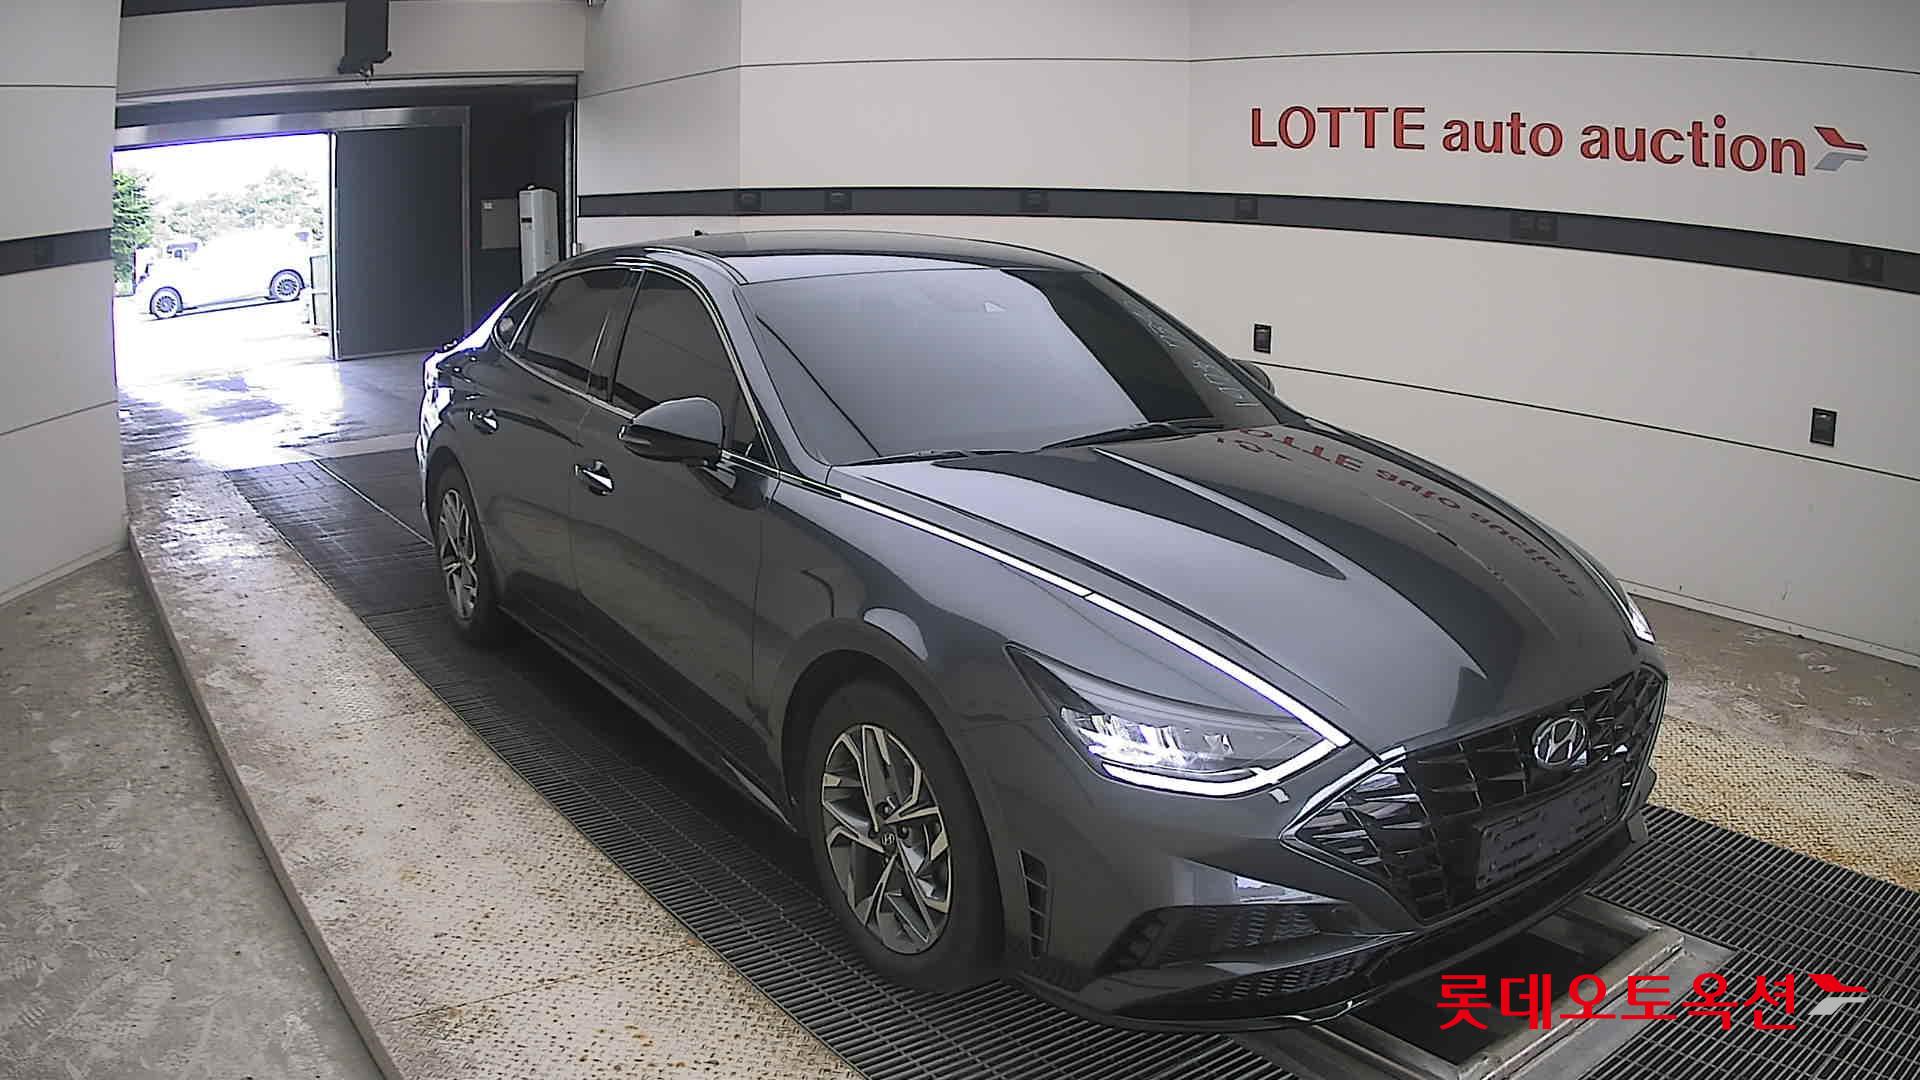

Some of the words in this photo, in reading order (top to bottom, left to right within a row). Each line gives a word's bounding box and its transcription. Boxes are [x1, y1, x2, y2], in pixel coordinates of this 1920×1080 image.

[1251, 105, 1425, 150] LOTTE
[1442, 112, 1564, 156] auto
[1580, 115, 1807, 175] auction
